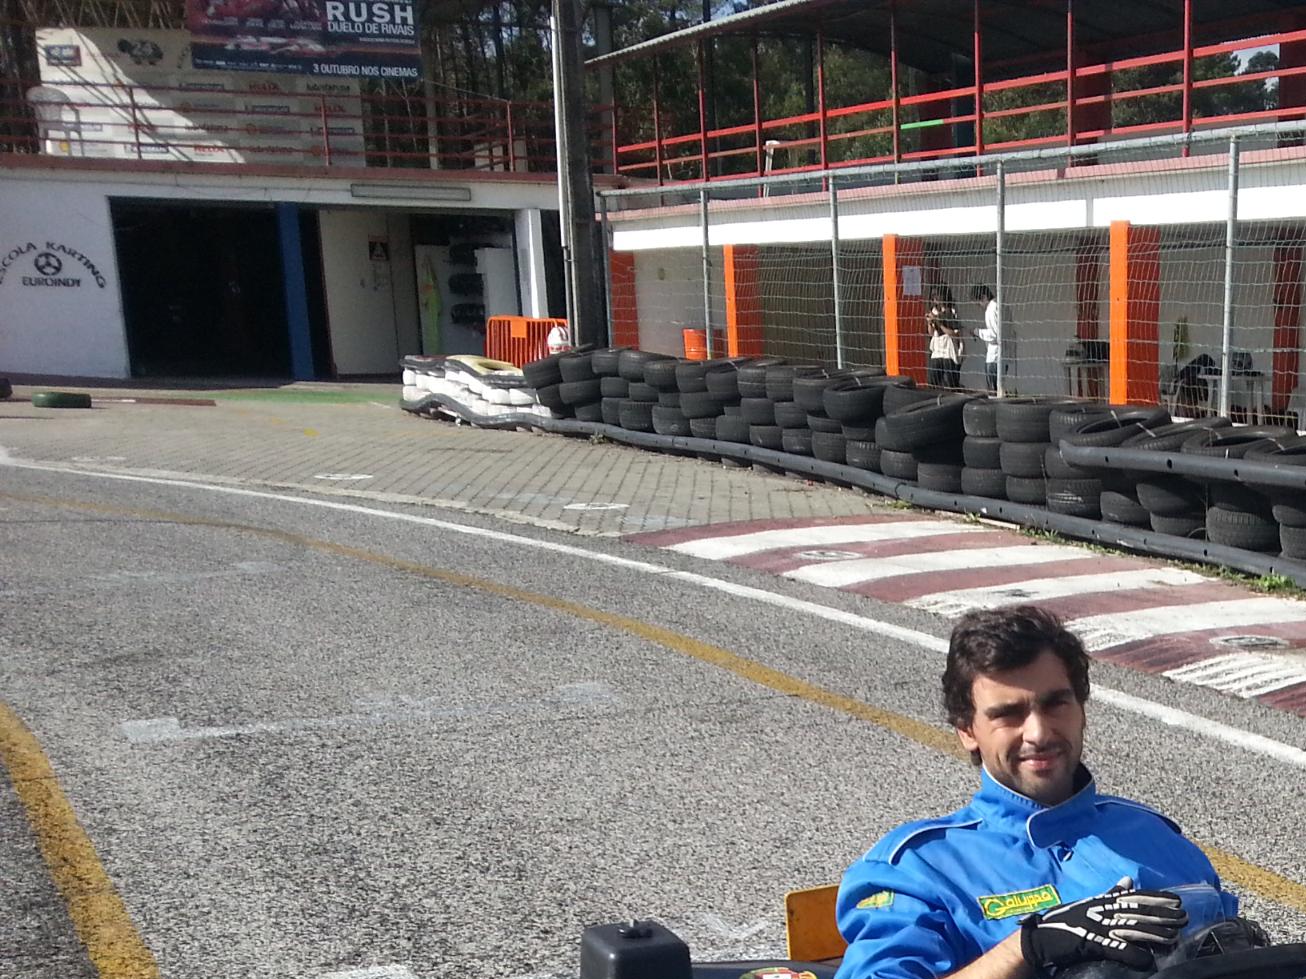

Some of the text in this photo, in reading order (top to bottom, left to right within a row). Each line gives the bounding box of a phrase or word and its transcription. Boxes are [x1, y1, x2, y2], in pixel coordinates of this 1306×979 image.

[326, 1, 414, 25] RUSH
[328, 21, 363, 33] DUELO
[365, 23, 379, 34] DE
[381, 24, 415, 36] RIVAIS
[312, 63, 319, 73] 3
[321, 64, 360, 75] OUTUBRO
[361, 66, 379, 76] NOS
[380, 67, 418, 77] CINEMAS
[46, 241, 107, 289] KARTING
